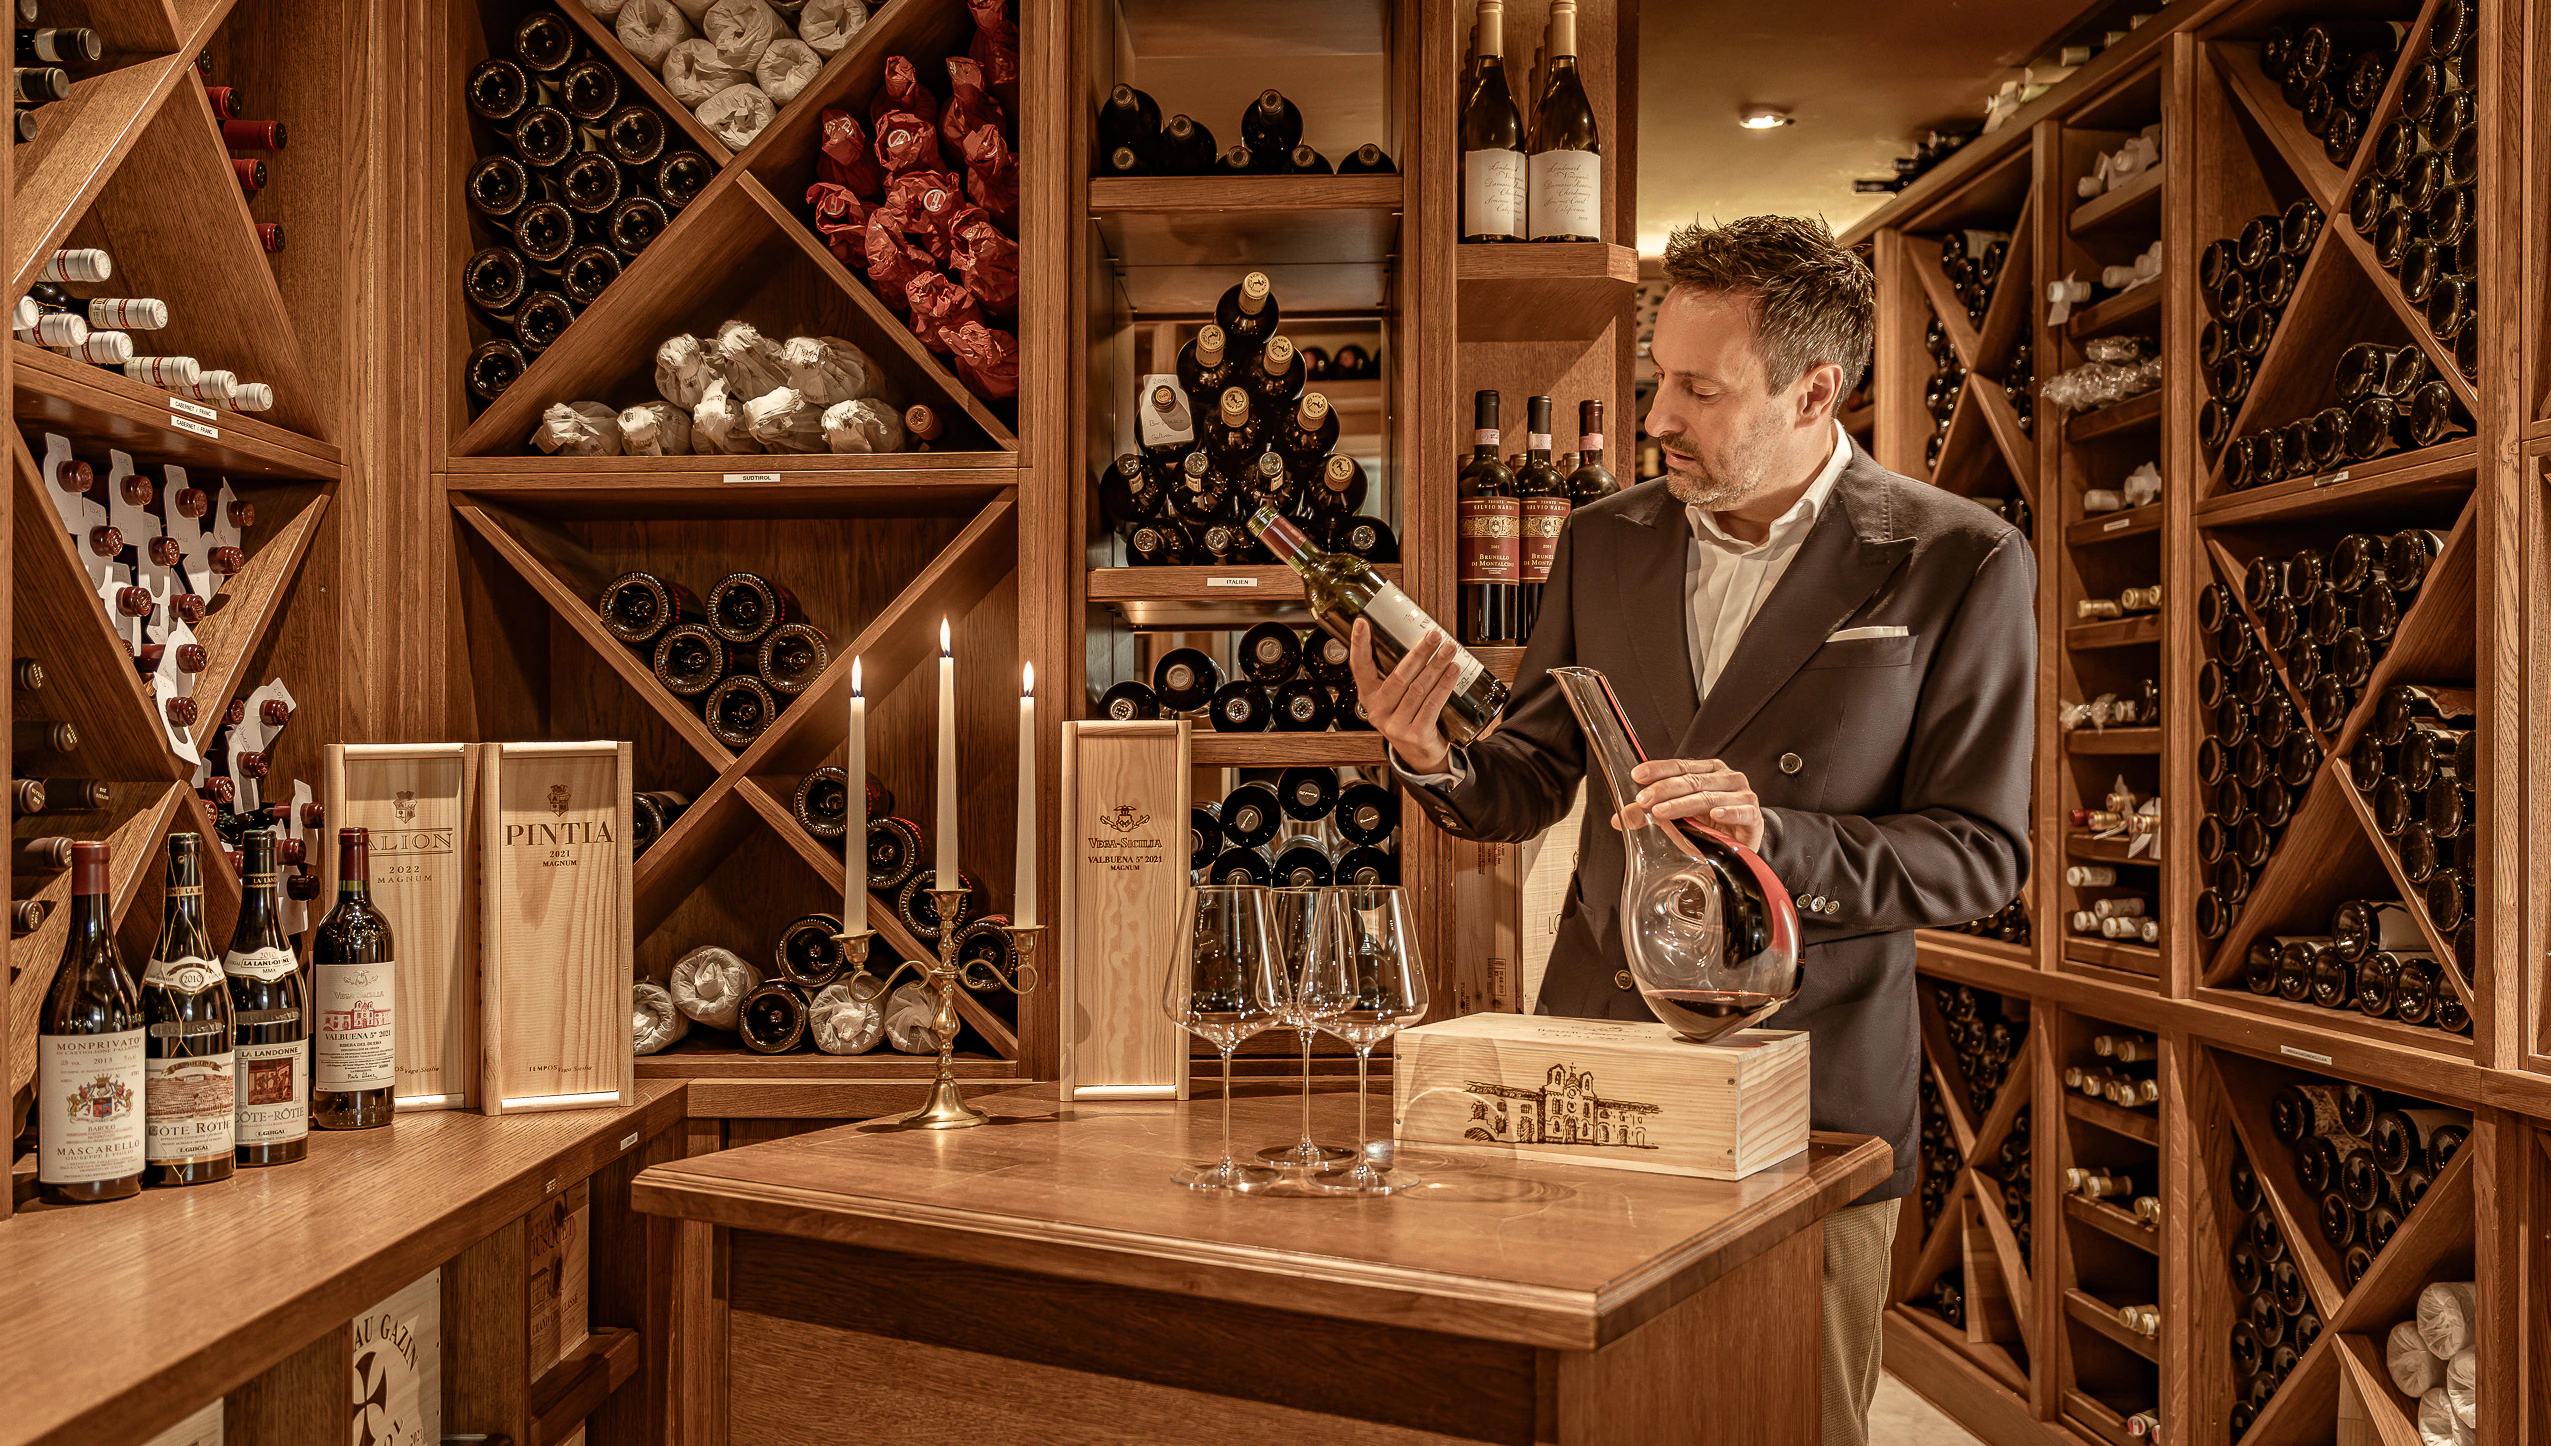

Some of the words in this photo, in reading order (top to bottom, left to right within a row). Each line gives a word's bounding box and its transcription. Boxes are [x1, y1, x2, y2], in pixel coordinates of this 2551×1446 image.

[175, 401, 195, 412] CABERNET
[176, 419, 196, 430] CABERNET
[200, 426, 213, 435] FRANC
[505, 820, 615, 847] PINTIA
[549, 850, 571, 858] 2021
[542, 859, 578, 867] MAGNUM
[1088, 856, 1134, 864] VALBUENA
[389, 865, 420, 874] 2022
[377, 874, 433, 884] MAGNUM
[185, 887, 195, 895] LA
[184, 974, 202, 983] 2010
[325, 1032, 368, 1041] VALBUENA
[57, 1036, 140, 1051] MONPRIVATO
[254, 1046, 299, 1057] LANDONNE
[93, 1057, 113, 1065] 2013
[88, 1124, 116, 1132] BAROLO
[57, 1139, 140, 1156] MASCARELLO
[112, 1149, 134, 1157] FIGLIO
[380, 1314, 420, 1373] GAZIN
